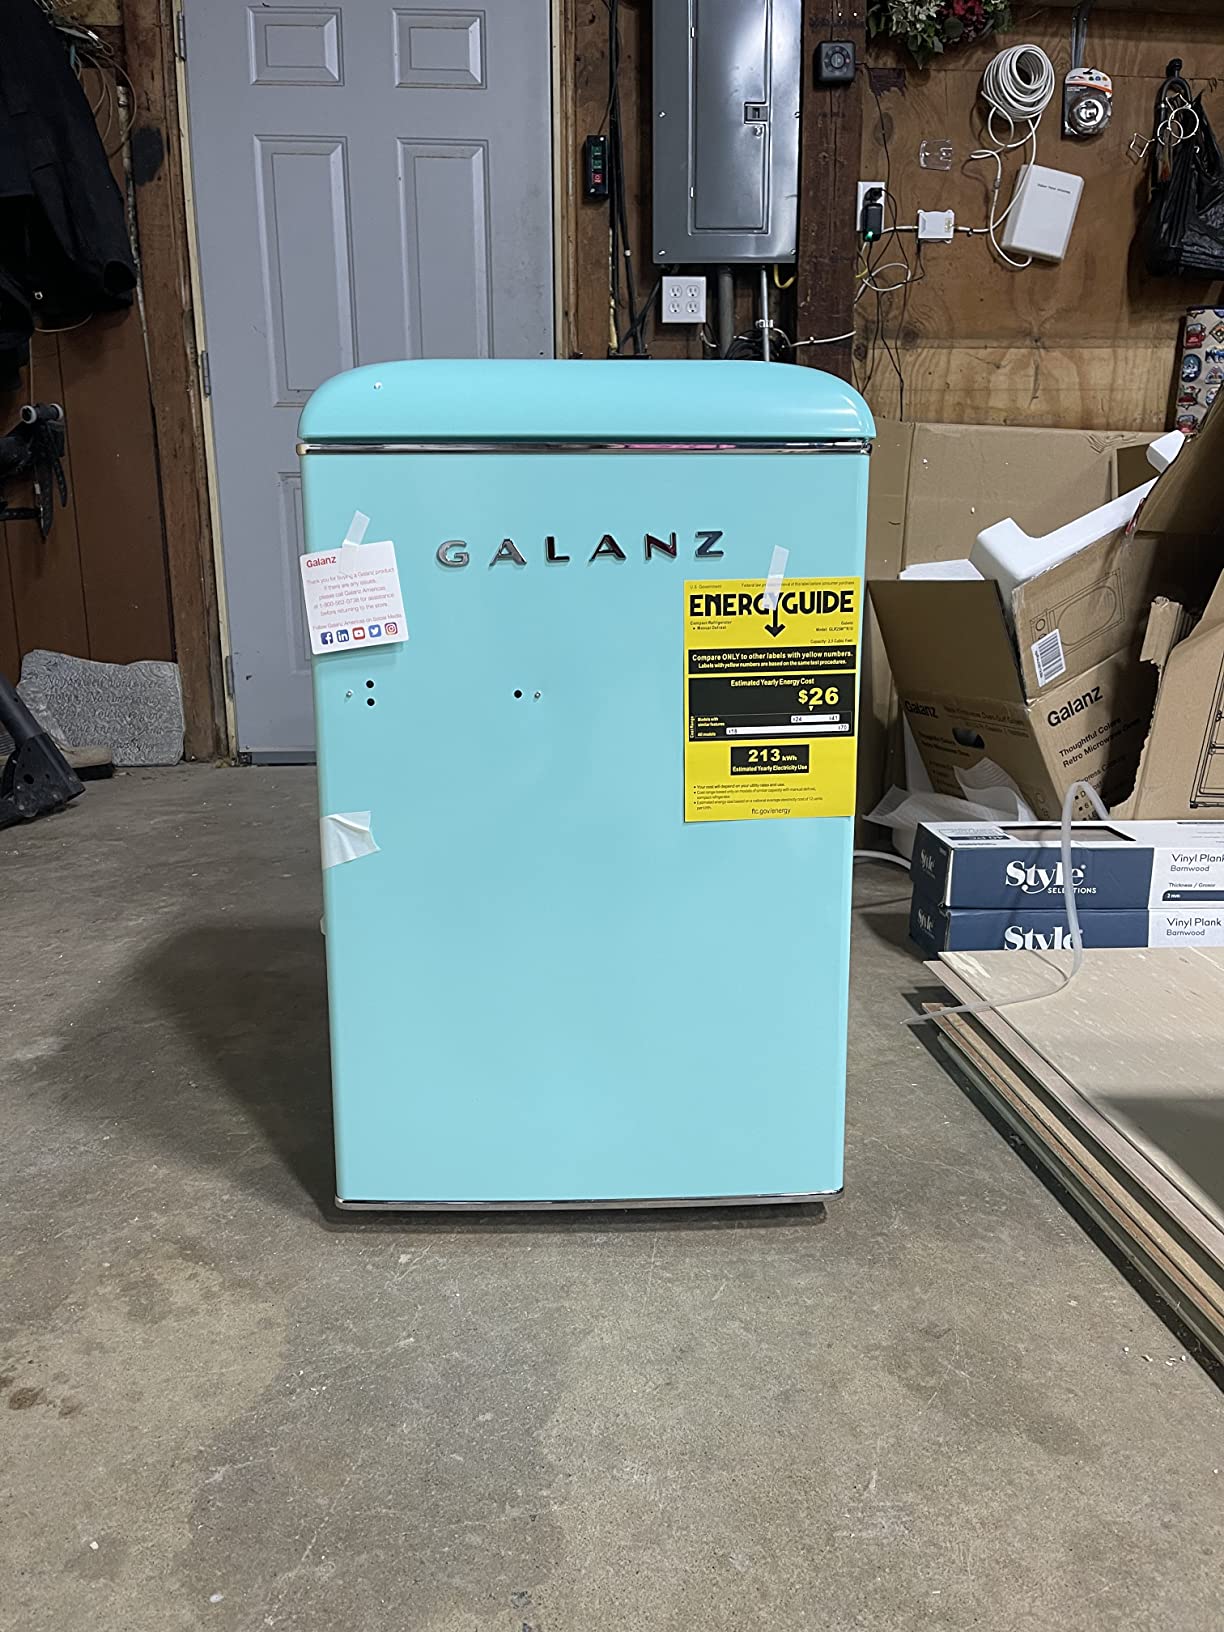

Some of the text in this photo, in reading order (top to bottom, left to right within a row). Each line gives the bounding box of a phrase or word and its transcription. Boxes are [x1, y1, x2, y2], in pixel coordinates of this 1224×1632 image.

[436, 531, 724, 568] GALANZ
[306, 556, 336, 568] Galanz
[692, 654, 721, 662] Compare
[801, 651, 822, 660] yellow
[760, 679, 779, 687] Yearly
[780, 678, 800, 686] Energy
[798, 687, 839, 706] $26
[904, 700, 938, 718] Galanz
[1048, 686, 1103, 726] Galanz
[1059, 731, 1097, 757] Thoughtful
[1063, 753, 1083, 768] Retro
[1084, 730, 1122, 755] Microwave
[748, 748, 781, 762] 213
[1172, 854, 1197, 865] Vinyl
[1005, 860, 1084, 894] Style
[1166, 918, 1222, 929] Vinyl Plank
